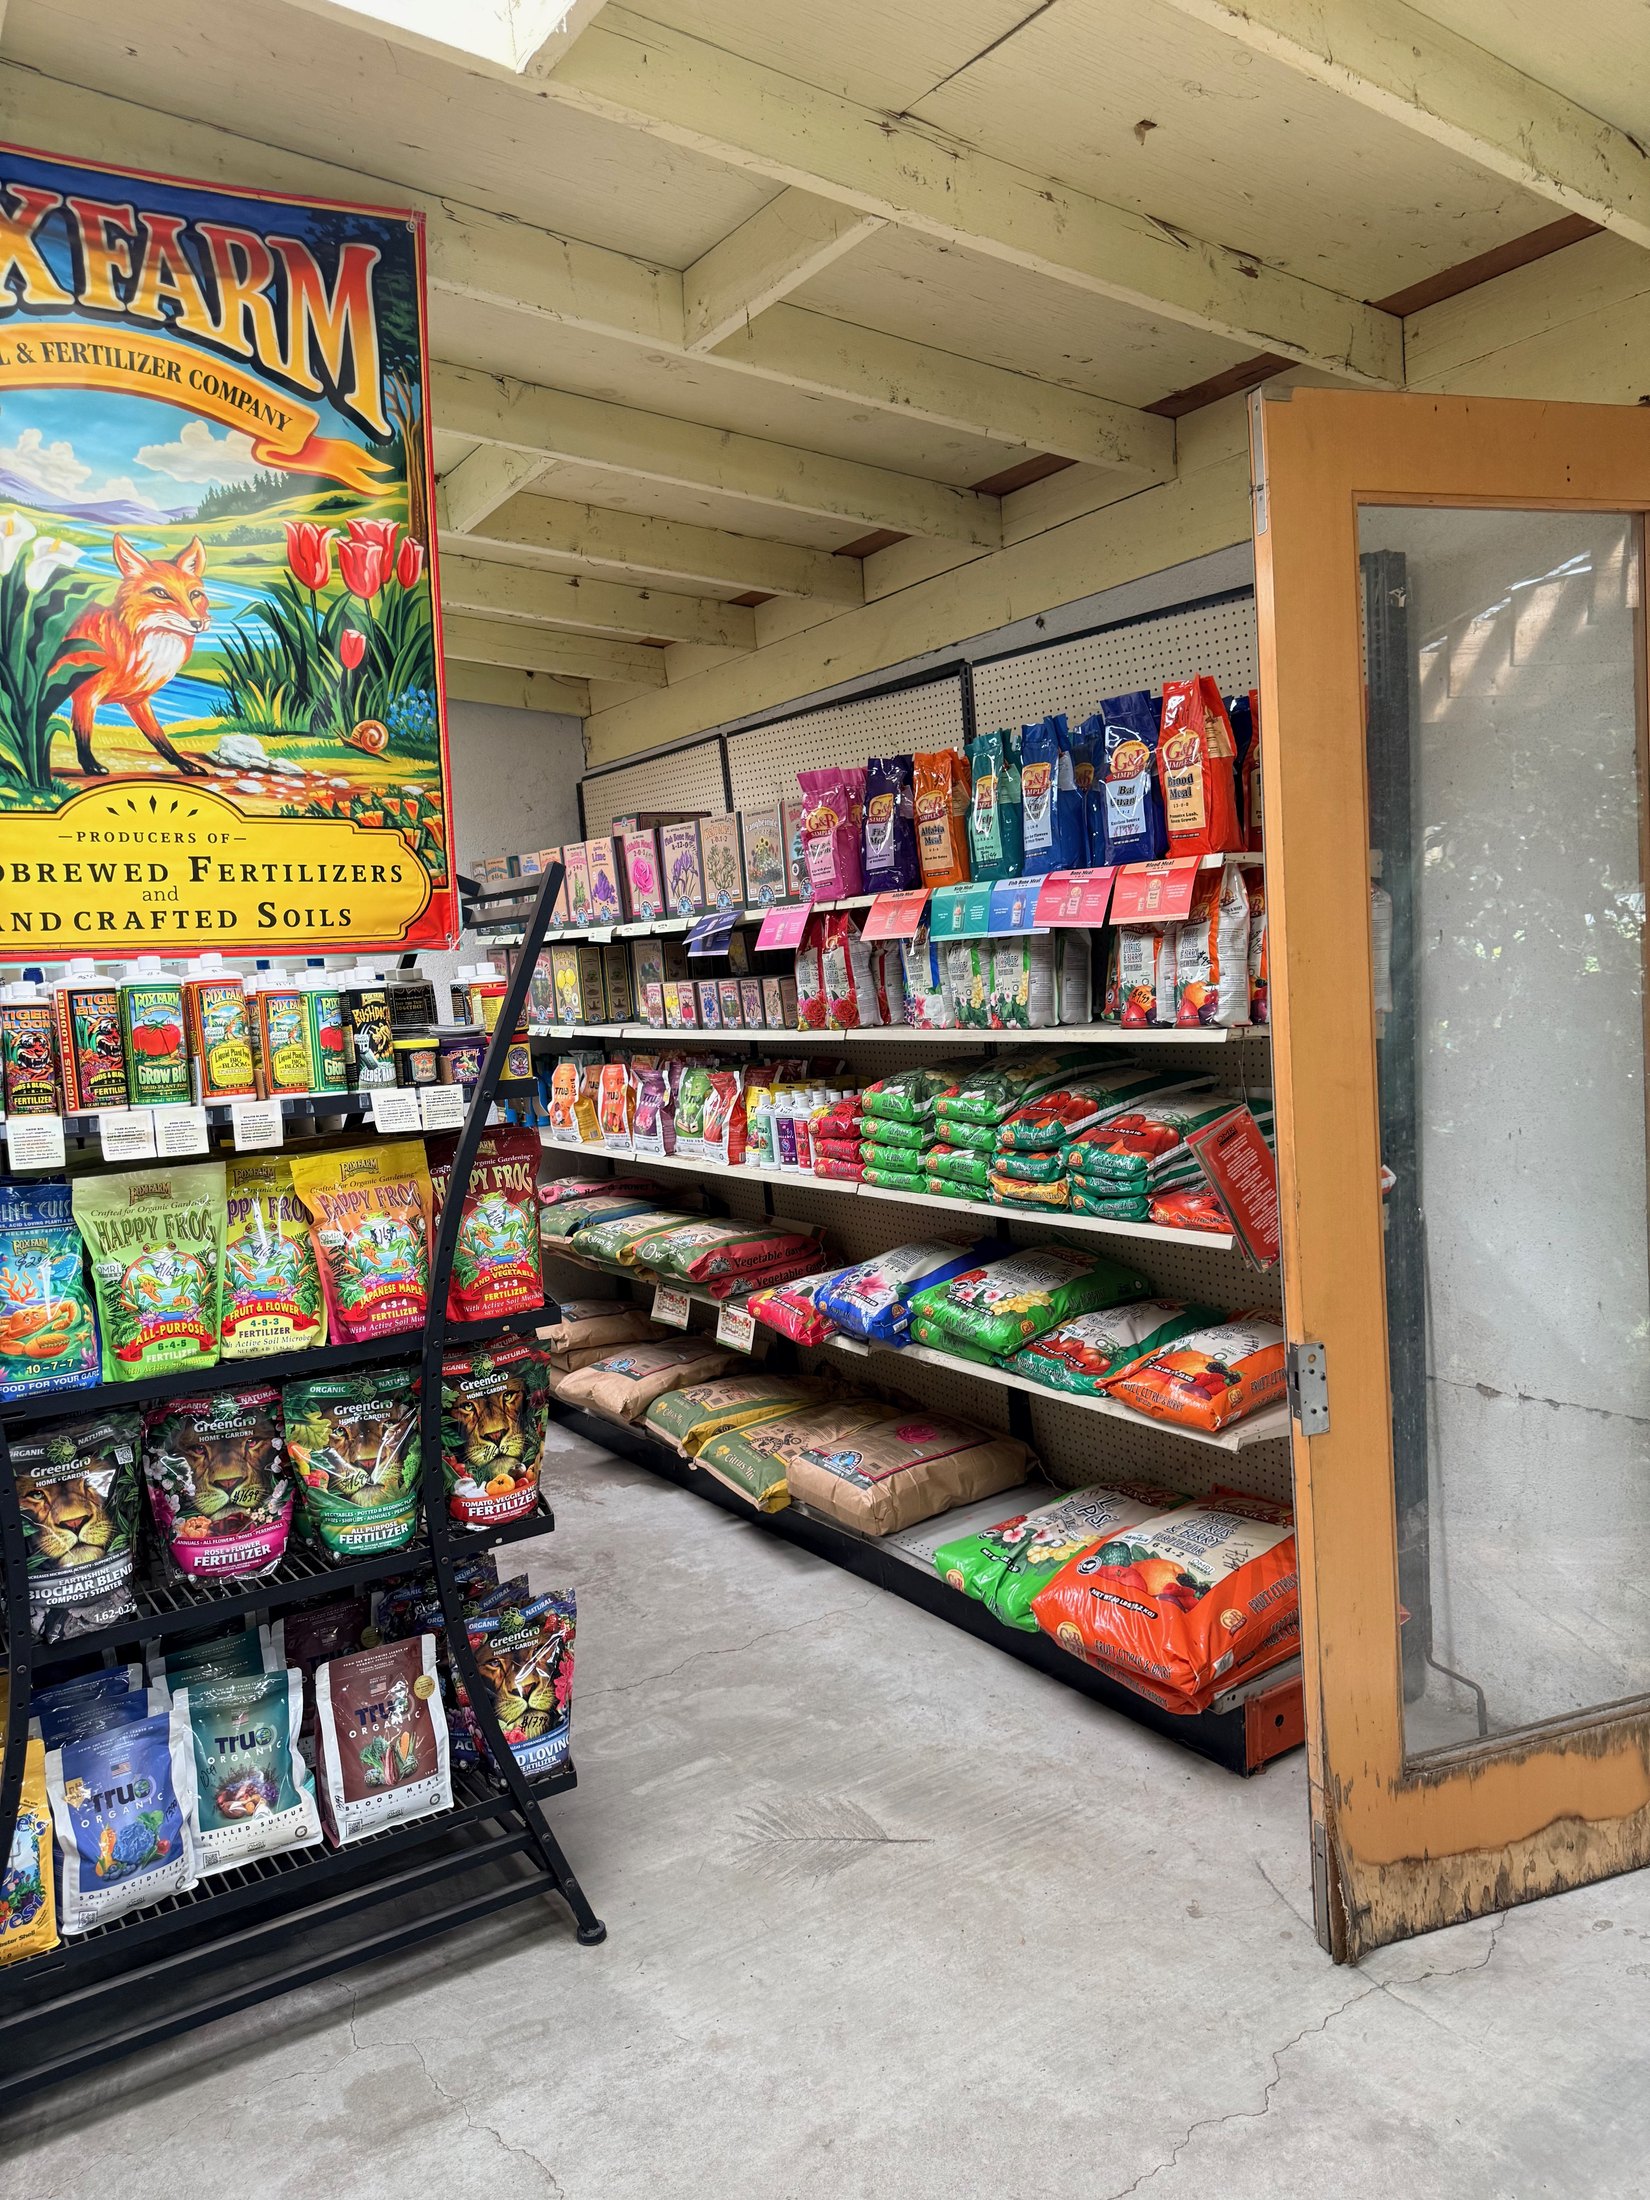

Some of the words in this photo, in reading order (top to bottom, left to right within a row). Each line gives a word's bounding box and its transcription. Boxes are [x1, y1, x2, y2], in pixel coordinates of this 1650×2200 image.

[16, 342, 37, 364] &
[40, 342, 183, 384] FERTILIZER
[189, 369, 293, 432] COMPANY
[76, 831, 197, 845] PRODUCERS
[208, 833, 230, 845] OF
[0, 863, 169, 883] BREWED
[188, 855, 403, 884] FERTILIZERS
[142, 886, 179, 902] and
[138, 1065, 168, 1085] GROW
[498, 1154, 530, 1163] Gardening
[350, 1179, 377, 1188] Organic
[379, 1173, 414, 1182] Gardening
[492, 1163, 533, 1195] FROG
[91, 1208, 123, 1217] Crafted
[123, 1207, 135, 1217] for
[137, 1203, 168, 1214] Organic
[93, 1214, 158, 1255] HAPPY
[163, 1208, 217, 1245] FROG
[734, 1249, 782, 1268] Vegetable
[490, 1263, 518, 1273] TOMATO
[473, 1276, 490, 1289] AND
[492, 1269, 535, 1279] VEGETABLE
[494, 1279, 518, 1290] 5-7-3
[756, 1267, 803, 1288] Vegetable
[360, 1283, 396, 1309] JAPANESE
[399, 1283, 423, 1296] MAPLE
[484, 1286, 527, 1301] FERTILIZER
[506, 1297, 520, 1306] Soil
[230, 1304, 254, 1321] FRUIT
[256, 1302, 263, 1312] &
[265, 1302, 300, 1316] FLOWER
[381, 1298, 408, 1310] 4-3-4
[250, 1318, 279, 1327] 4-9-3
[371, 1306, 418, 1321] FERTILIZER
[239, 1327, 290, 1338] FERTILIZER
[369, 1321, 392, 1331] Active
[395, 1318, 409, 1326] Soil
[136, 1322, 205, 1346] ALL-PURPOSE
[263, 1336, 279, 1345] Soil
[158, 1339, 187, 1350] 6-4-5
[146, 1348, 197, 1363] FERTILIZER
[496, 1347, 530, 1362] NATURAL
[29, 1380, 50, 1390] FOR
[54, 1375, 79, 1386] YOUR
[460, 1372, 510, 1391] GreenGro
[240, 1388, 278, 1404] NATURAL
[466, 1391, 484, 1400] HOME
[486, 1385, 508, 1395] GARDEN
[333, 1400, 394, 1416] GreenGro
[194, 1416, 257, 1433] GreenGro
[78, 1427, 113, 1445] NATURAL
[199, 1434, 220, 1443] HOME
[225, 1430, 254, 1439] GARDEN
[30, 1456, 91, 1478] GreenGro
[724, 1452, 747, 1472] Citrus
[36, 1477, 57, 1488] HOME
[62, 1470, 90, 1481] GARDEN
[468, 1489, 538, 1517] FERTILIZER
[339, 1522, 409, 1545] FERTILIZER
[366, 1520, 398, 1532] PURPOSE
[1181, 1517, 1236, 1540] CITRUS
[1179, 1527, 1226, 1549] BERRY
[194, 1544, 272, 1567] FERTILIZER
[204, 1548, 224, 1556] ROSE
[231, 1540, 261, 1553] FLOWER
[59, 1566, 111, 1586] EARTHSHINE
[97, 1562, 133, 1587] BLEND
[46, 1591, 89, 1605] COMPOST
[90, 1580, 123, 1597] STARTER
[1091, 1588, 1104, 1599] NET
[469, 1619, 499, 1629] ORGANIC
[526, 1597, 553, 1616] NATURAL
[489, 1625, 540, 1648] GreenGro
[494, 1646, 511, 1656] HOME
[345, 1793, 393, 1811] BLOOD
[406, 1776, 439, 1794] MEAL
[81, 1792, 164, 1828] ORGANIC
[201, 1825, 250, 1842] PRILLED
[260, 1806, 304, 1828] SULFUR
[80, 1890, 111, 1901] SOIL
[122, 1857, 185, 1891] ACIDIFIER
